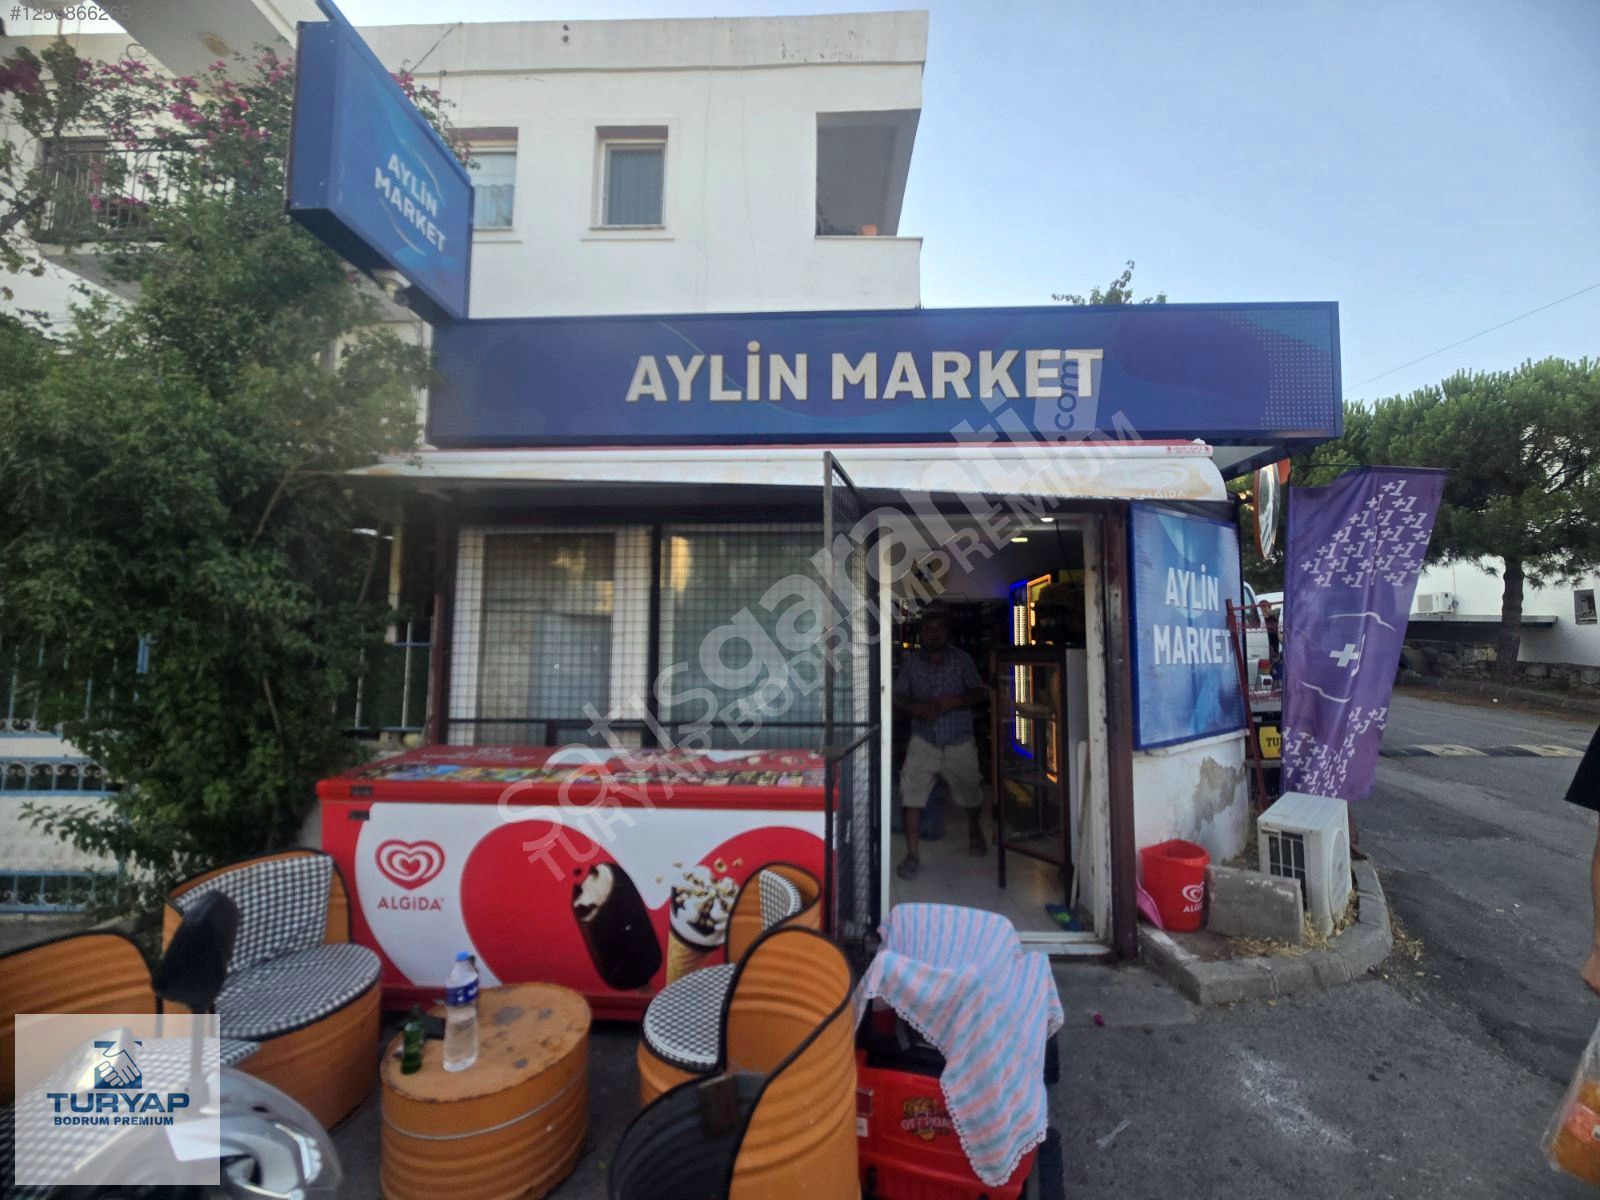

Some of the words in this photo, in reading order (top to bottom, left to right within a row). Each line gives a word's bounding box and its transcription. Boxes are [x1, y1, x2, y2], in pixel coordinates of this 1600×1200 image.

[387, 153, 437, 218] AYLİN
[374, 166, 446, 252] MARKET
[625, 341, 808, 403] AYLİN
[831, 348, 1104, 401] MARKET
[1382, 480, 1407, 496] +1
[1392, 496, 1417, 512] +1
[1349, 511, 1370, 527] +1
[1402, 512, 1427, 528] +1
[1332, 526, 1352, 543] +1
[1381, 526, 1404, 542] +1
[1317, 543, 1337, 558] +1
[1344, 542, 1365, 557] +1
[1391, 543, 1416, 557] +1
[1301, 558, 1321, 574] +1
[1329, 557, 1349, 572] +1
[1165, 564, 1219, 612] AYLİN
[1314, 572, 1333, 587] +1
[1342, 572, 1364, 588] +1
[1384, 571, 1407, 586] +1
[1153, 624, 1231, 665] MARKET
[901, 1115, 952, 1130] OFFROA
